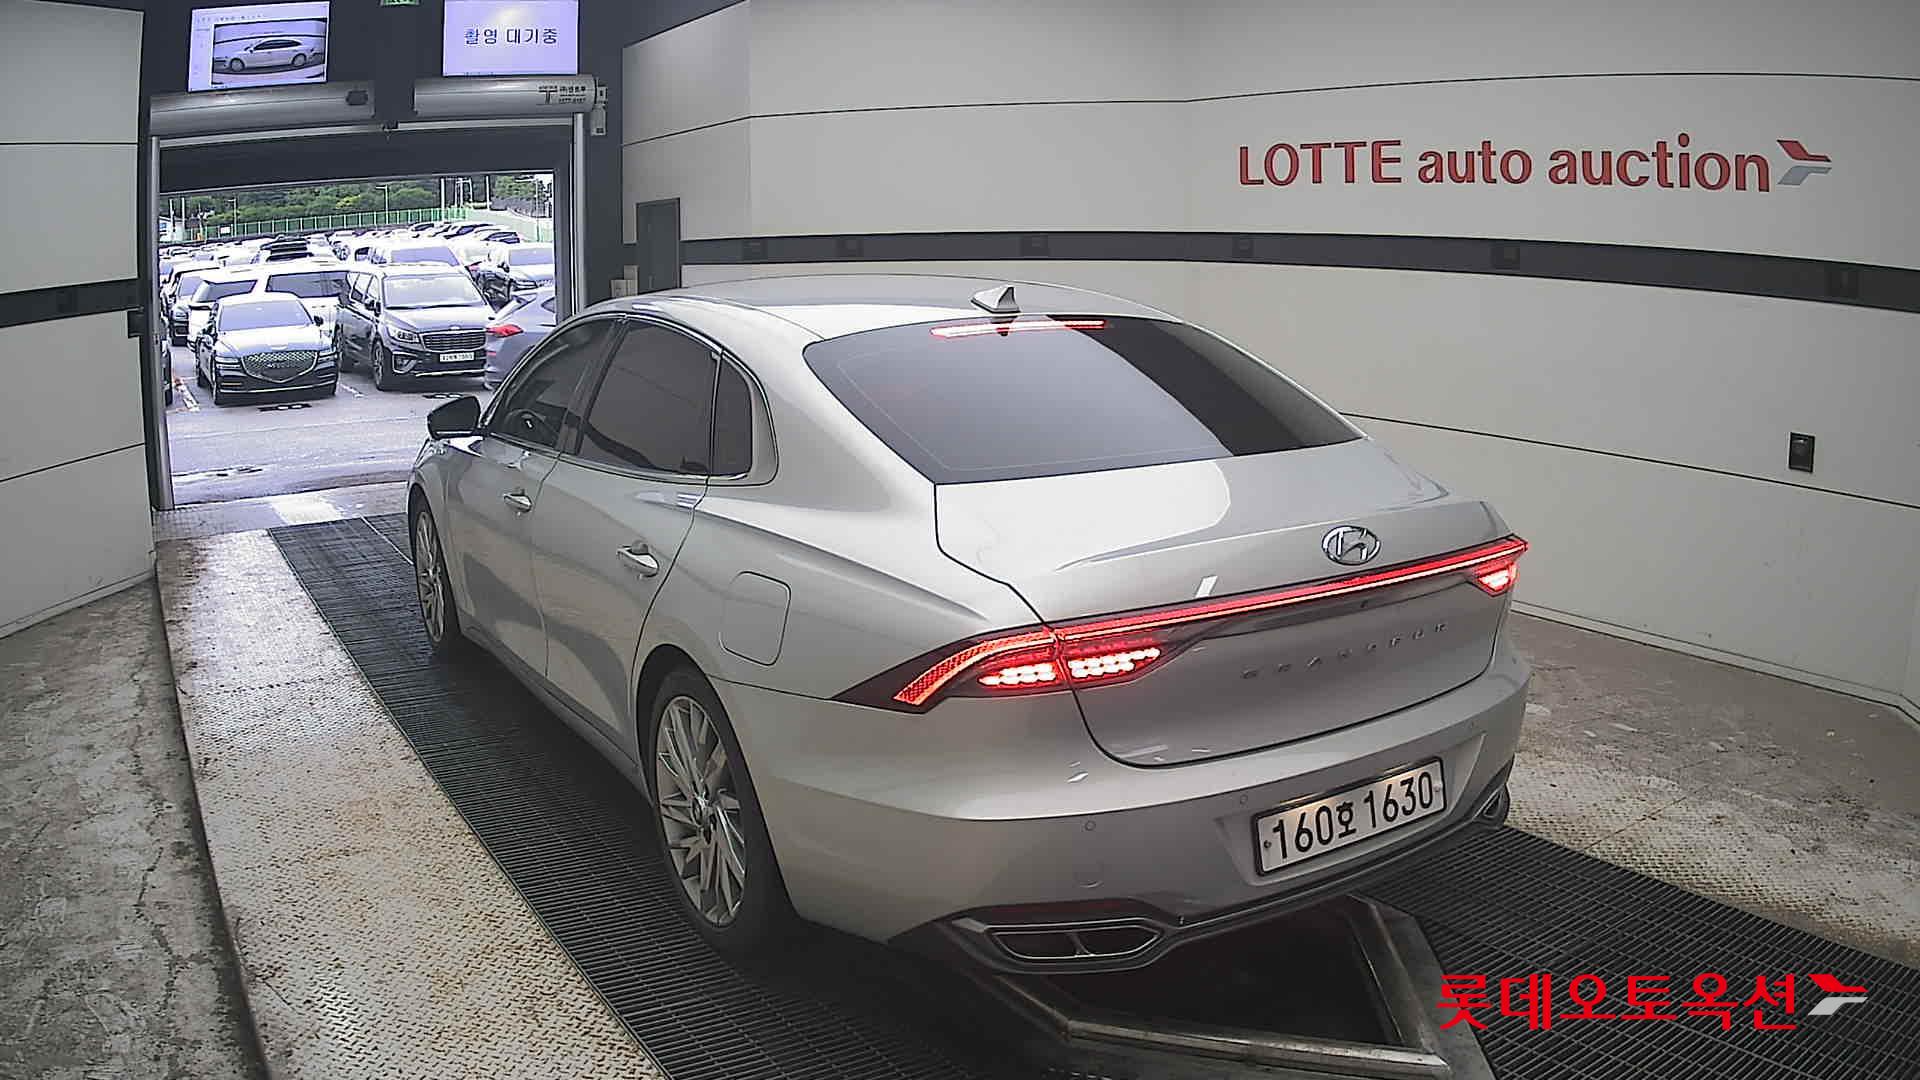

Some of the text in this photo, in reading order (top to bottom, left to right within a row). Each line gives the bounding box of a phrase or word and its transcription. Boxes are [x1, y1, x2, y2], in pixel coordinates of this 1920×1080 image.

[505, 28, 558, 45] 대기중
[1239, 132, 1770, 193] LOTTE auto auction
[1272, 771, 1434, 860] 160호 1630
